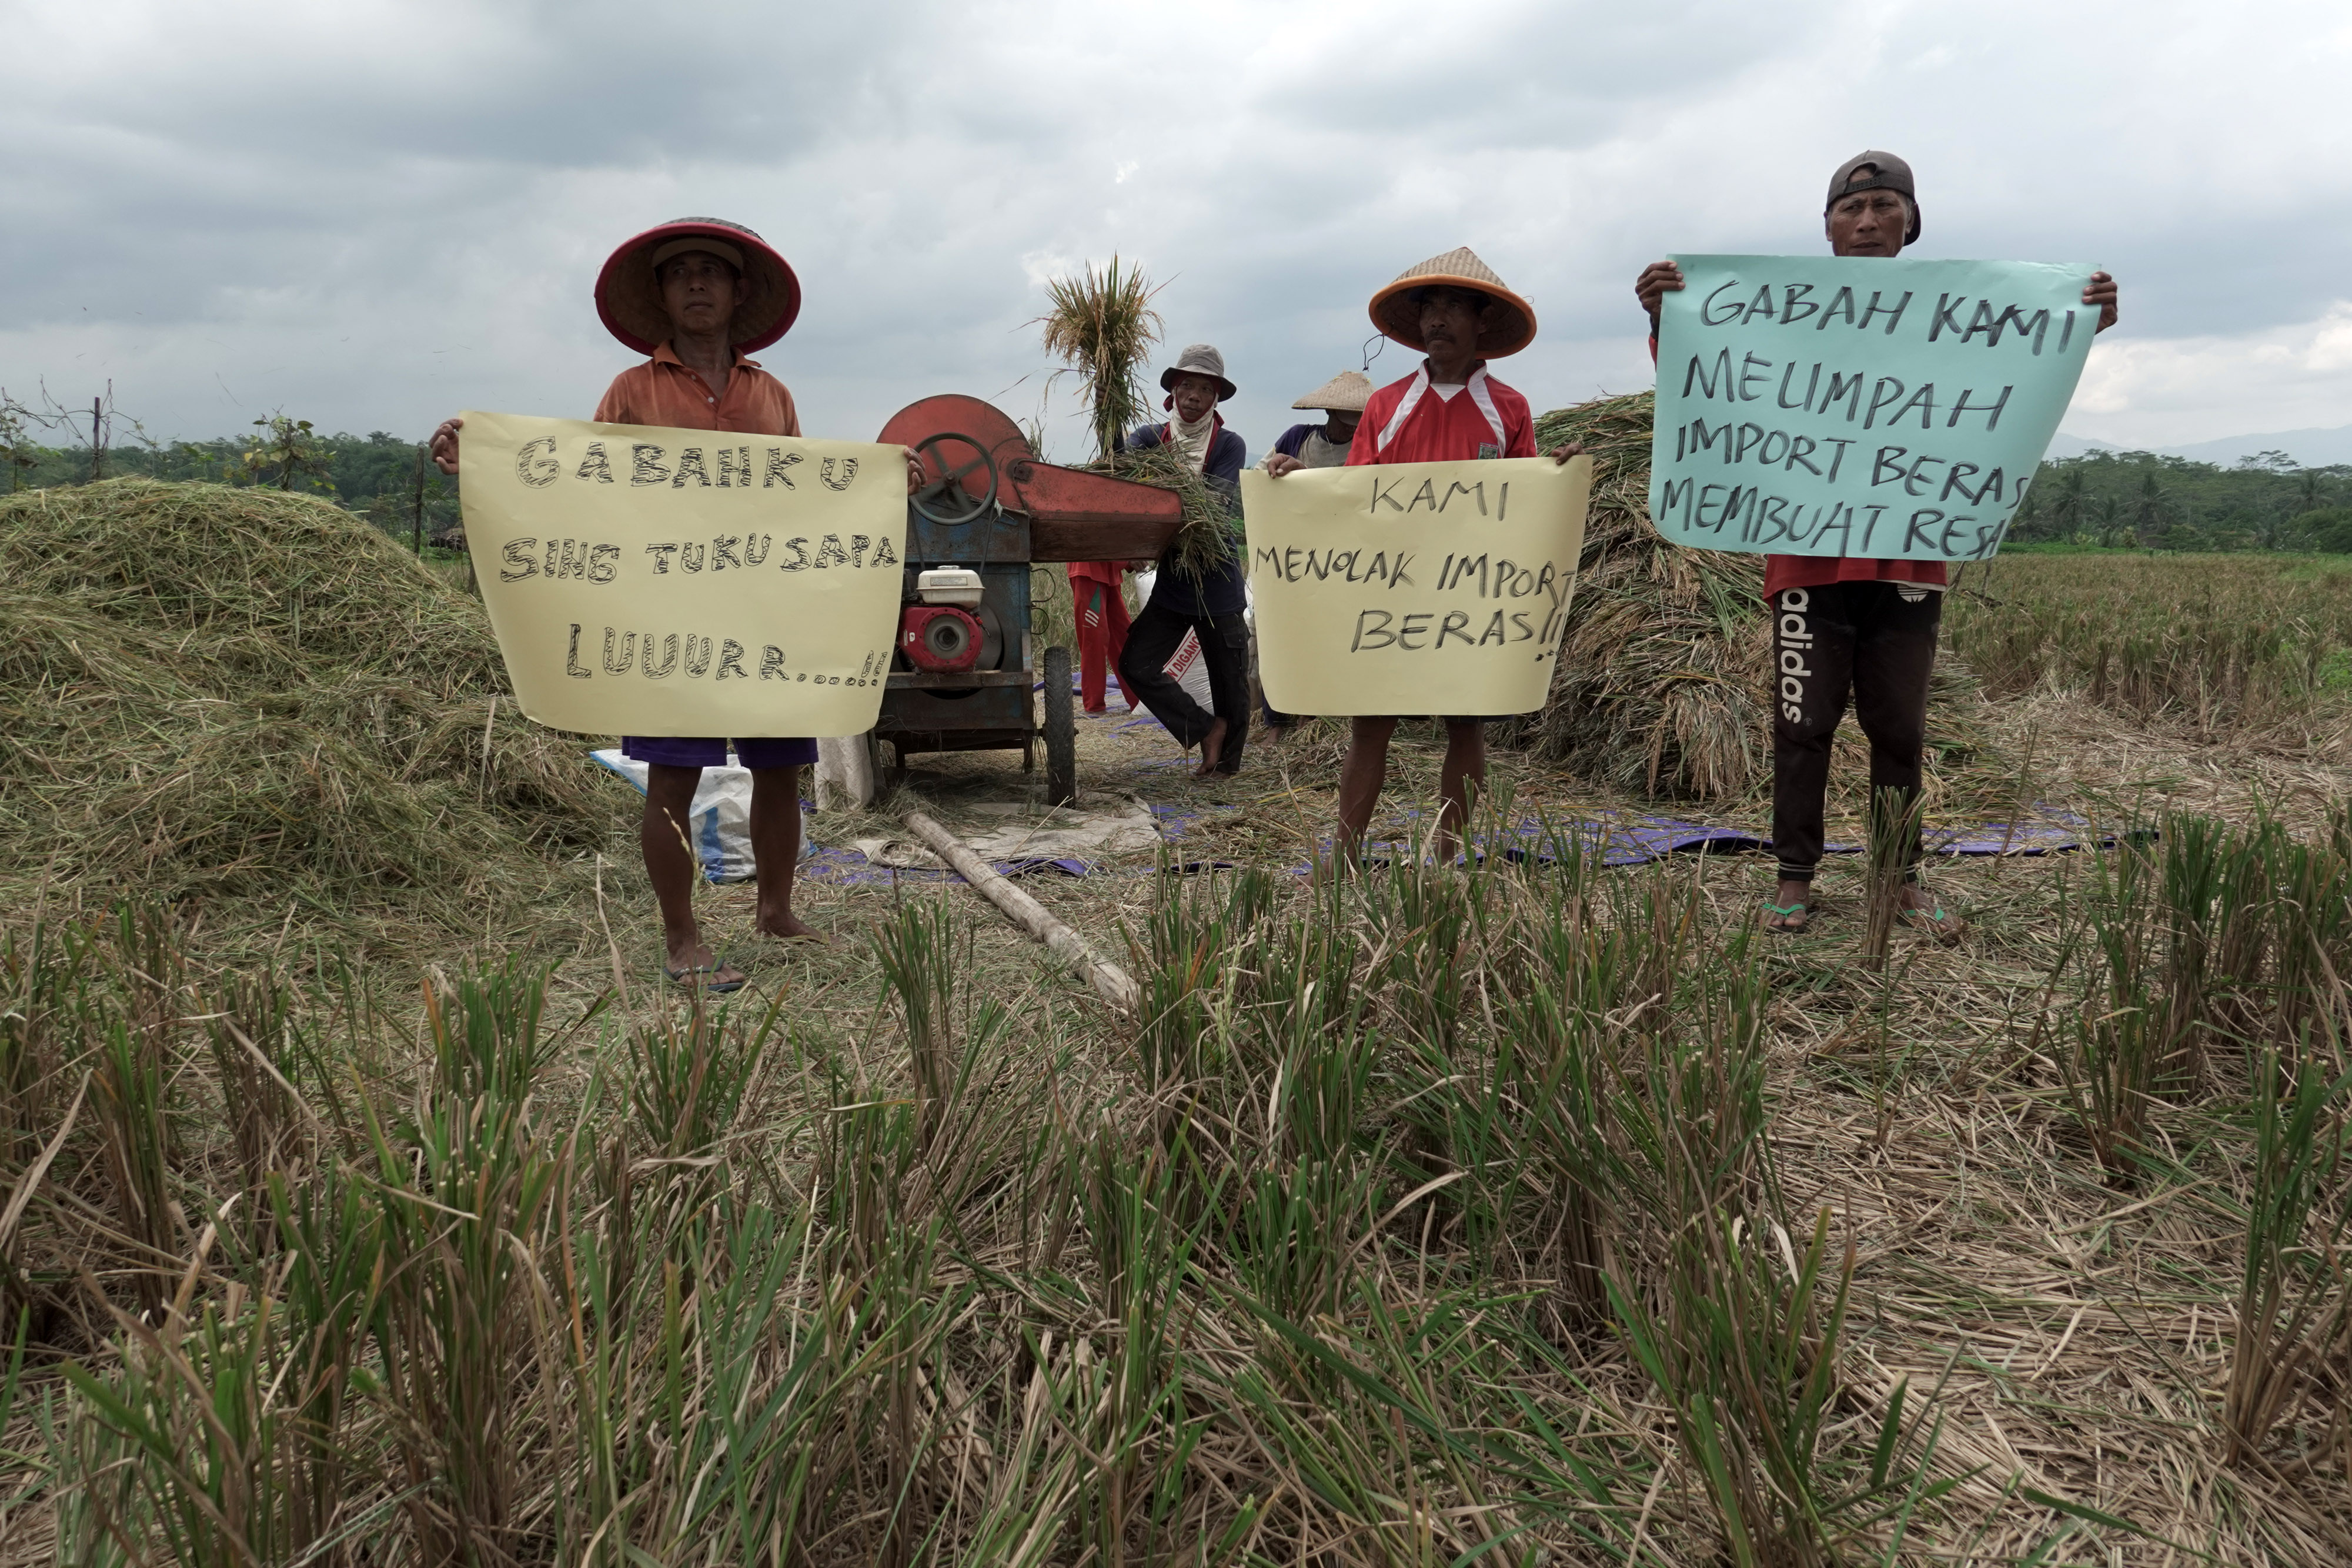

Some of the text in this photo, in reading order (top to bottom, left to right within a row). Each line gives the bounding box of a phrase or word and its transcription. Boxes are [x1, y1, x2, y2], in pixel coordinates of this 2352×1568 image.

[1700, 280, 2076, 356] GABAH KAMI
[1682, 346, 2014, 432] MELIMPAH
[516, 436, 858, 490] GABAHKU
[1371, 477, 1509, 521] KAMI
[1675, 417, 2029, 509] IMPORT BERAS
[780, 533, 898, 572] SAPA
[1659, 477, 1890, 558] MEMBUAT
[1256, 544, 1576, 608] MENOLAK IMPORT
[1780, 587, 1813, 724] adidas
